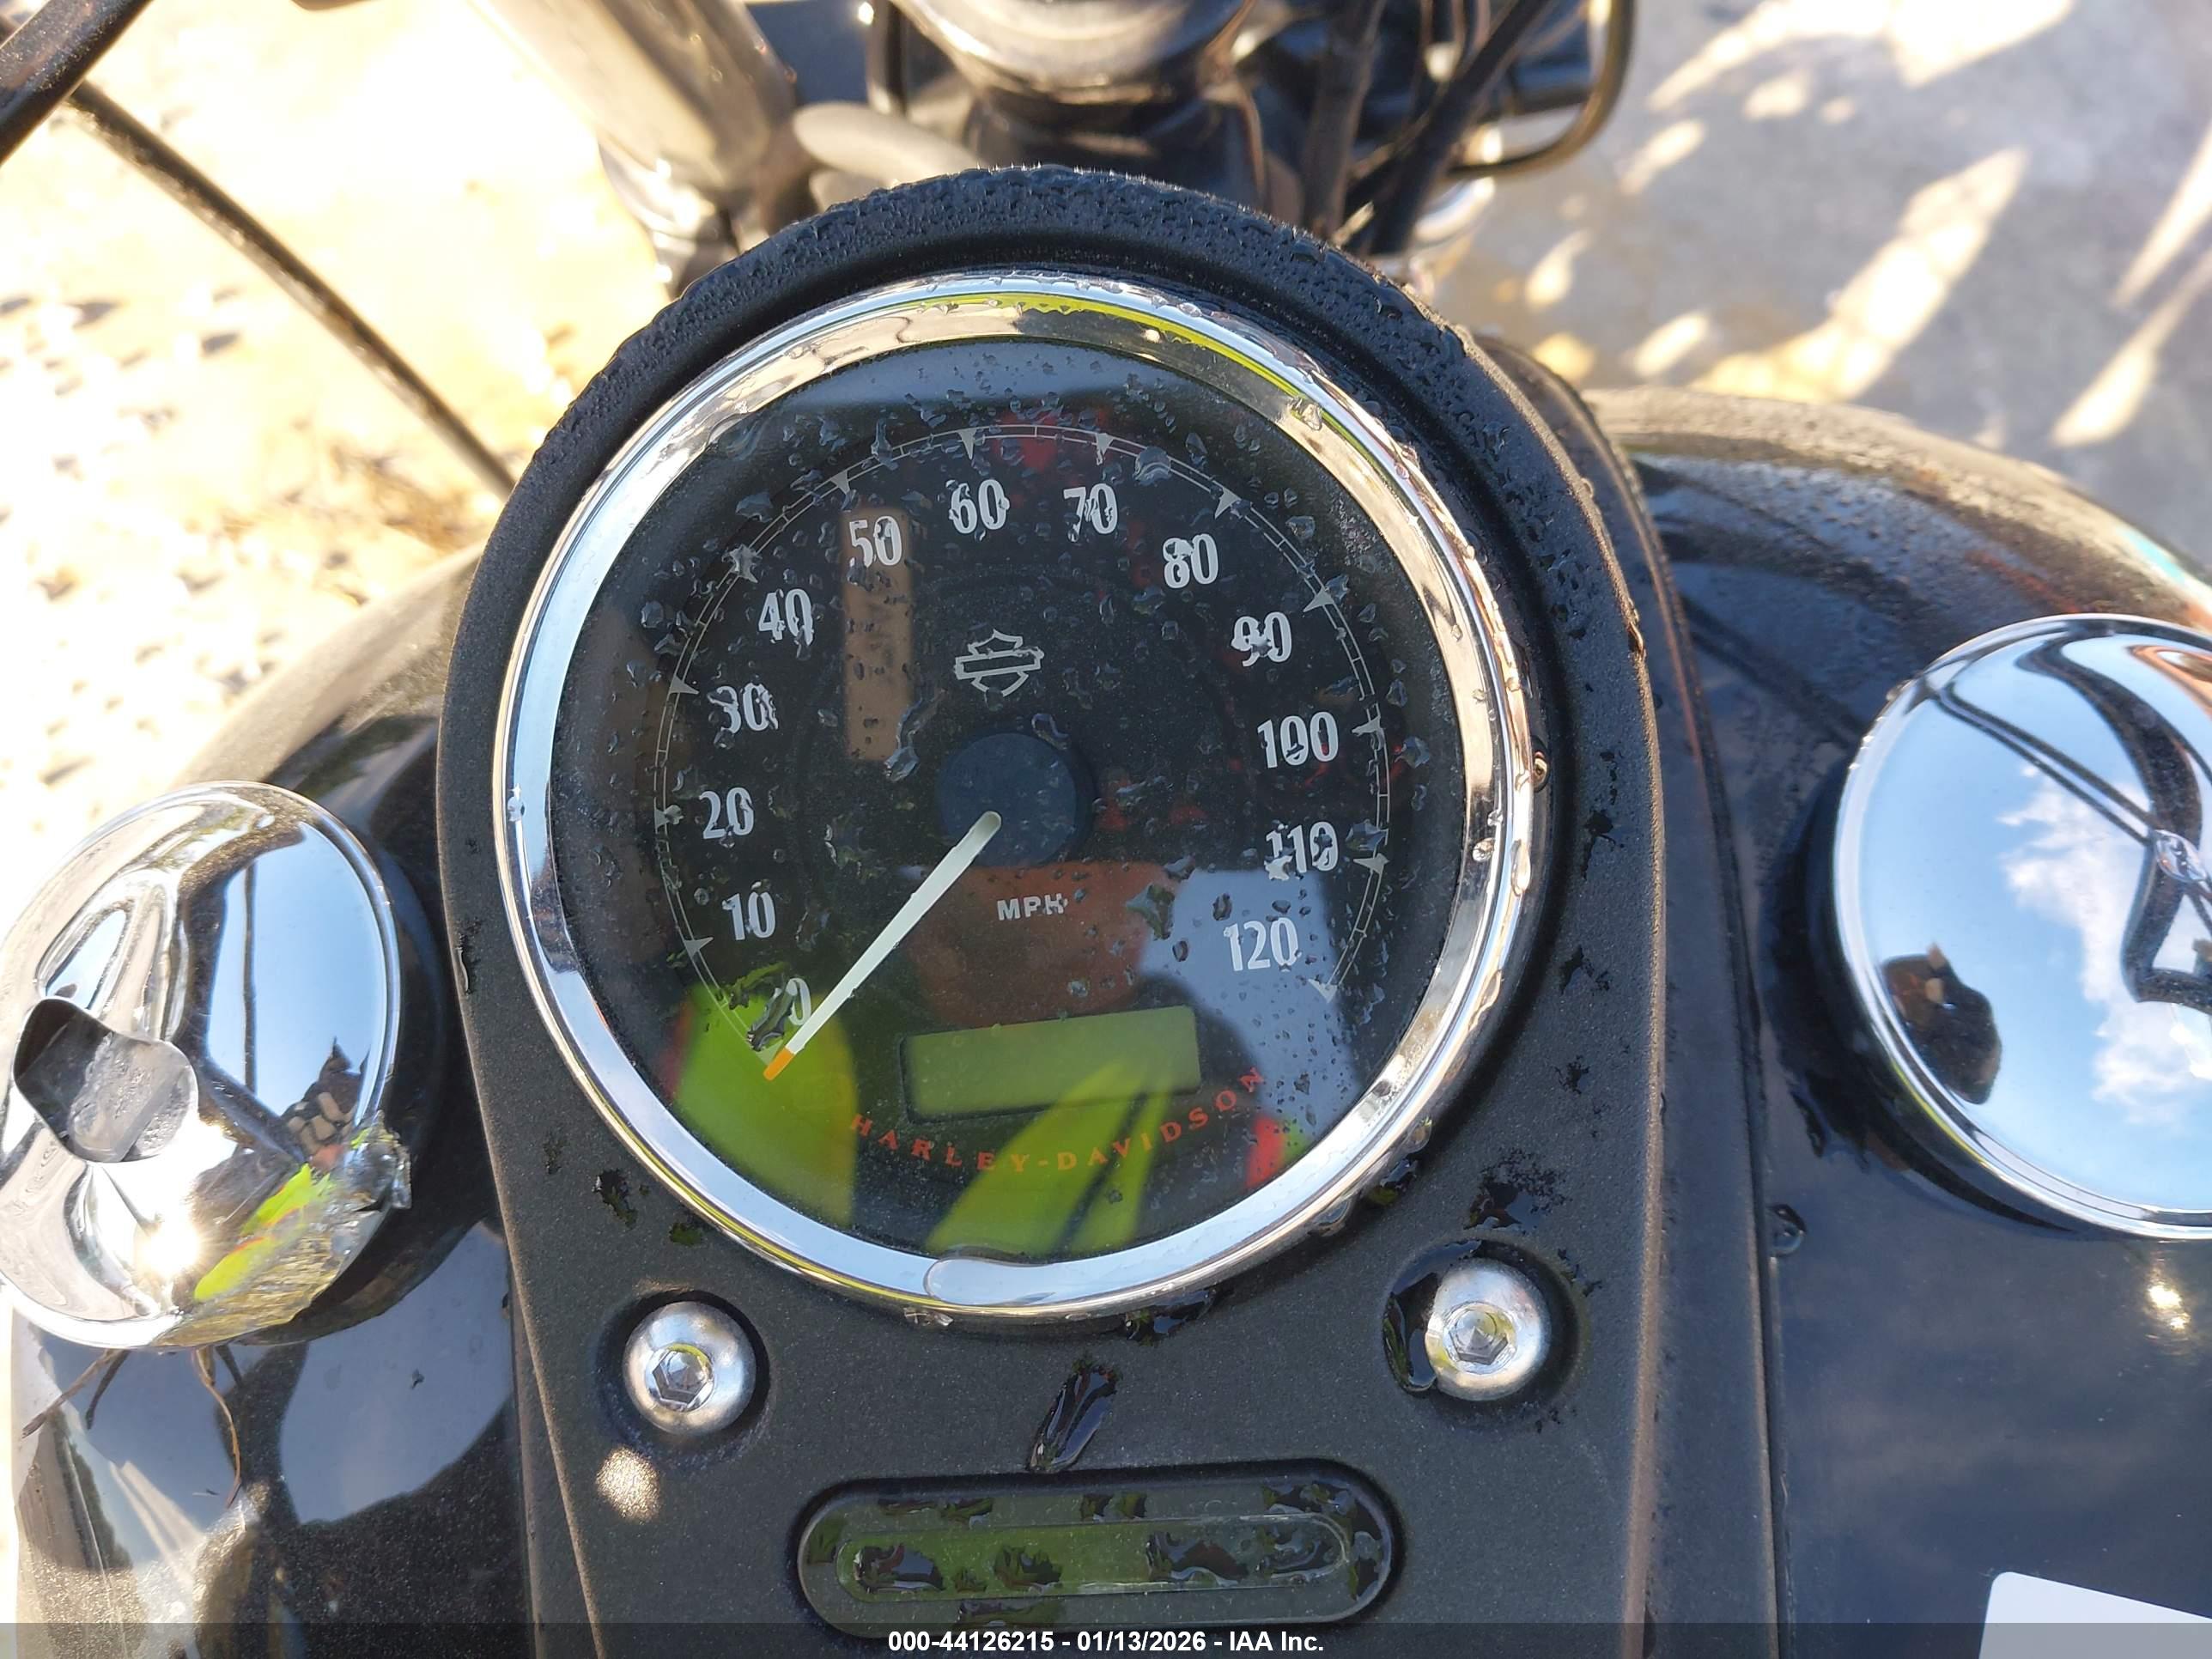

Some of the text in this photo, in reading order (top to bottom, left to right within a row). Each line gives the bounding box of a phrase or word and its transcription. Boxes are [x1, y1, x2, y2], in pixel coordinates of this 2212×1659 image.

[950, 479, 1010, 534] 60
[1063, 483, 1117, 536] 70
[849, 515, 902, 568] 50
[1162, 533, 1218, 588] 80
[759, 589, 813, 646] 40
[1231, 611, 1292, 667] 90
[1258, 711, 1338, 769] 100
[699, 787, 755, 839] 20
[722, 890, 776, 940] 10
[997, 893, 1067, 921] MPH
[1224, 917, 1301, 971] 120
[850, 1066, 1265, 1172] HARLEY-DAVIDSON
